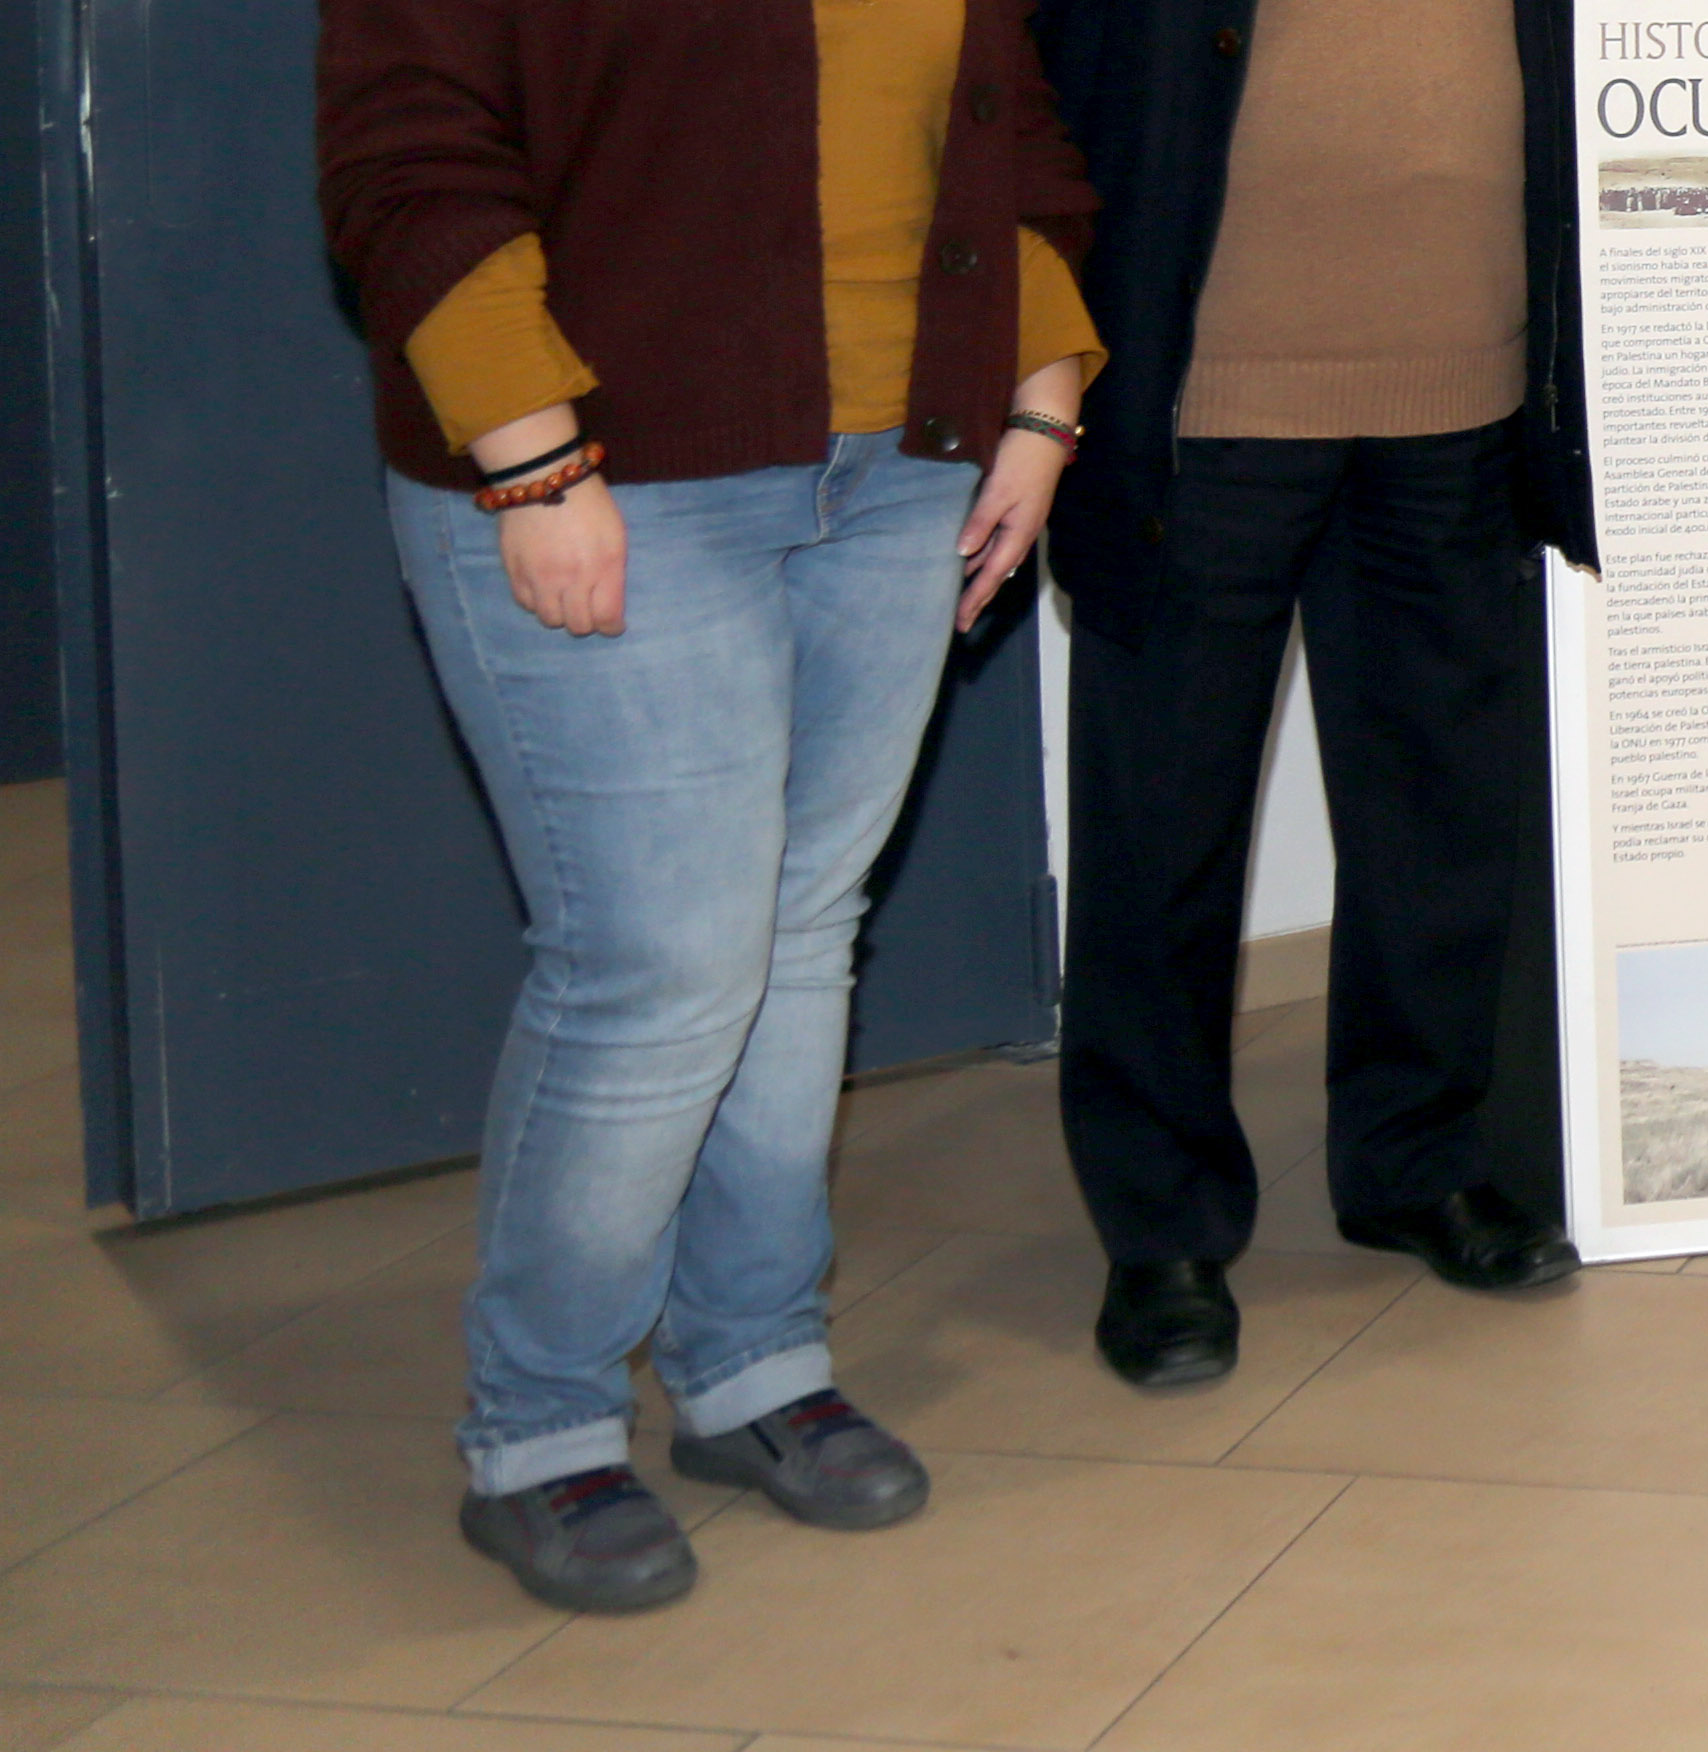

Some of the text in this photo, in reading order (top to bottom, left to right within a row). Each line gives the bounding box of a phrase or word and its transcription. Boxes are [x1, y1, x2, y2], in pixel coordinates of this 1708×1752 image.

[1600, 248, 1607, 257] A
[1609, 247, 1643, 257] finales
[1645, 247, 1661, 256] del
[1664, 246, 1688, 257] siglo
[1690, 246, 1707, 255] XIX
